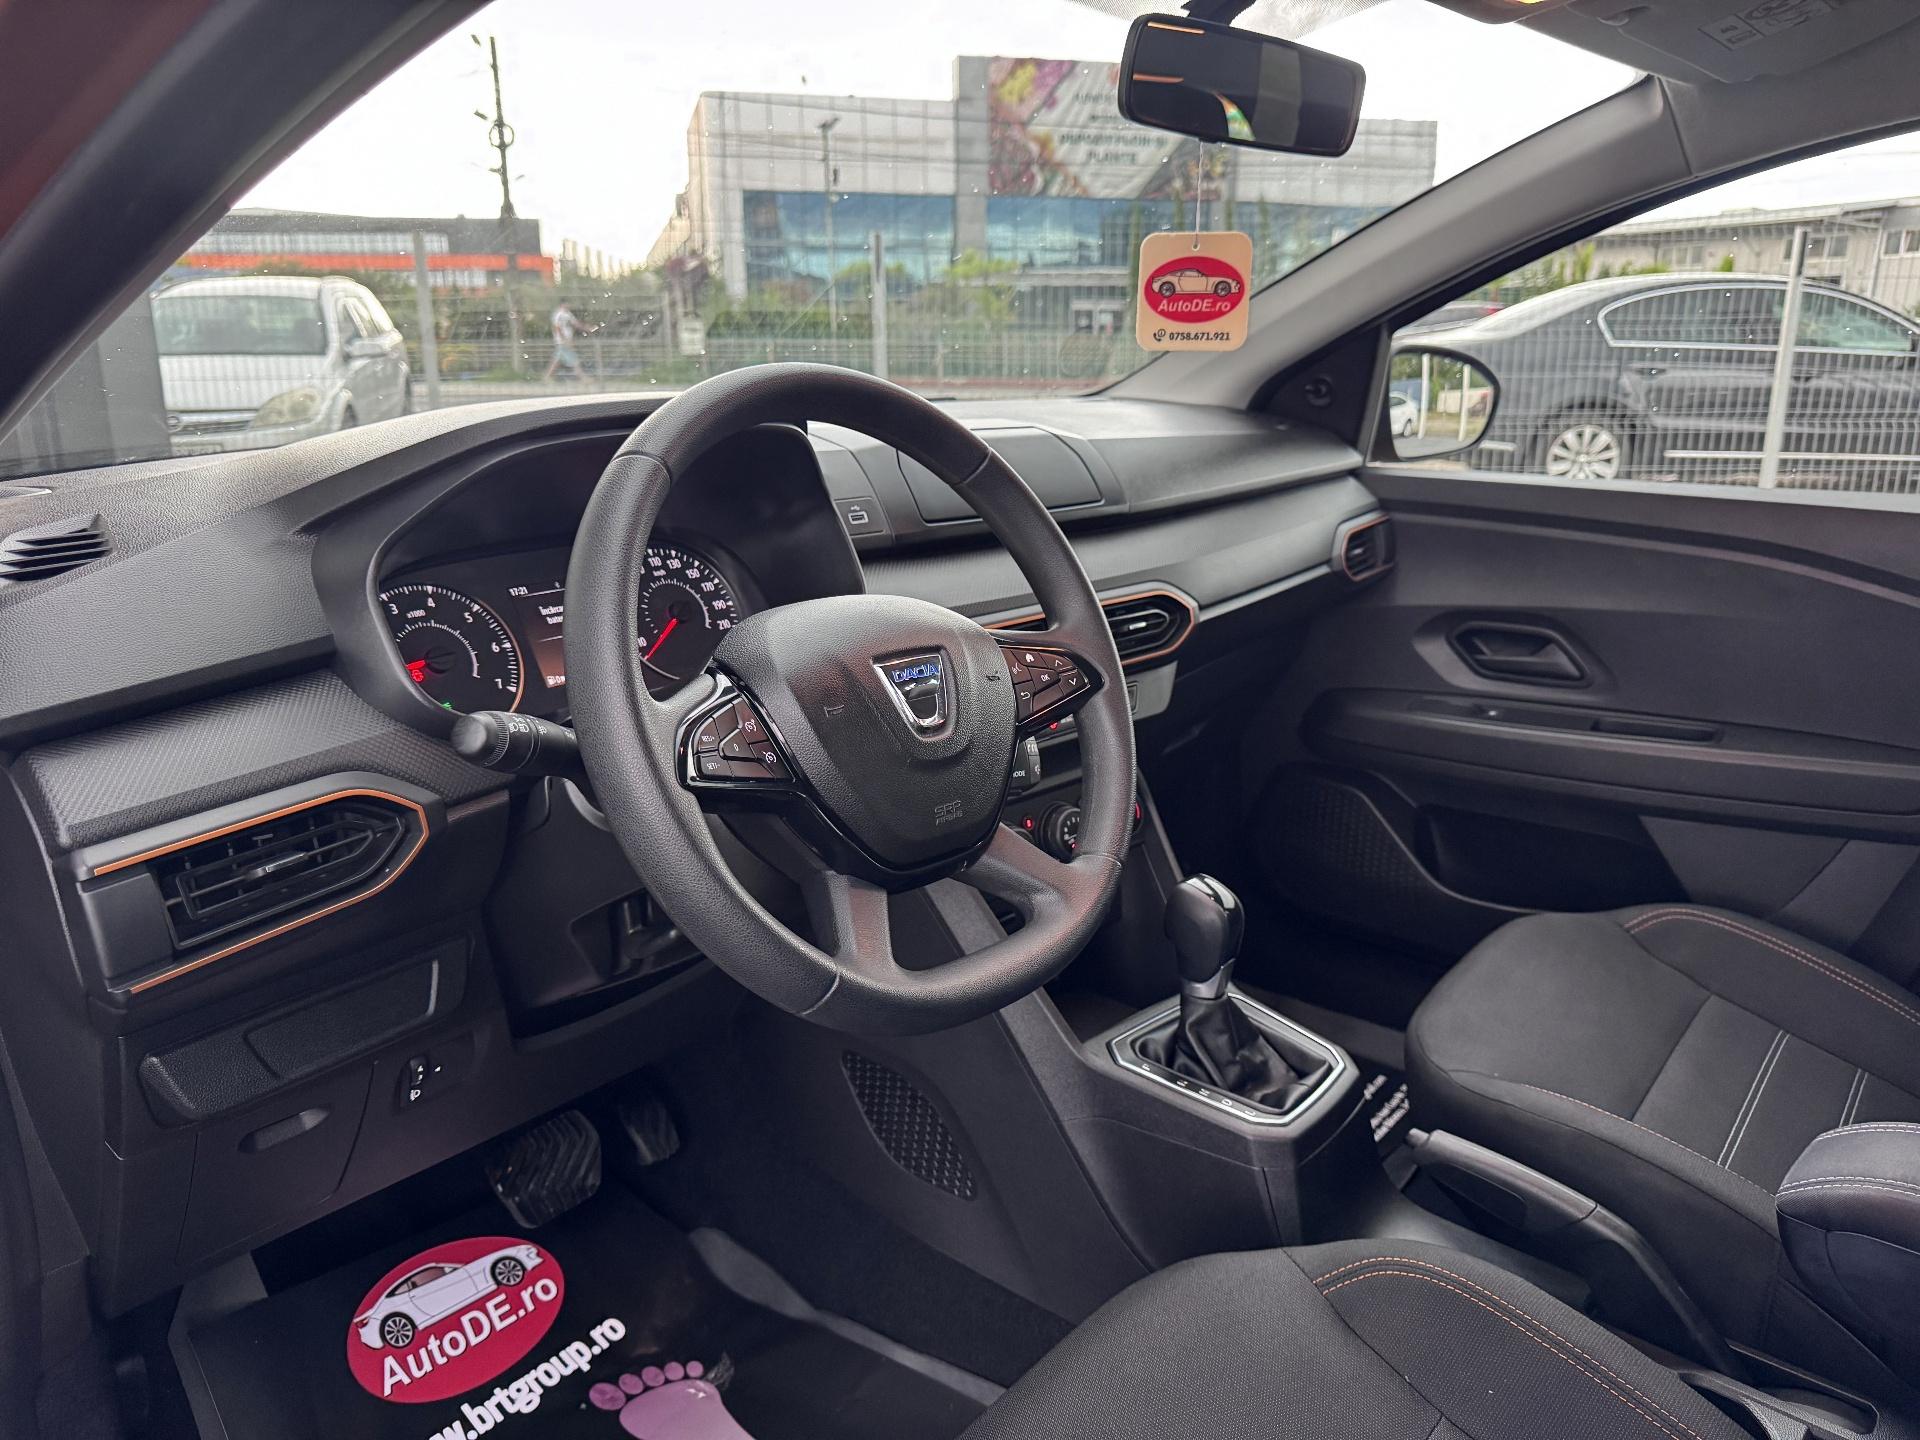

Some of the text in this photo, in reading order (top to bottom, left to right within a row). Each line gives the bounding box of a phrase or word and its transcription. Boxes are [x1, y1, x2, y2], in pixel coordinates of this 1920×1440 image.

[1157, 299, 1231, 312] AutoDE.ro
[1169, 332, 1230, 341] 0758.671.921
[648, 557, 662, 567] 110
[666, 558, 681, 569] 130
[686, 568, 700, 579] 150
[509, 586, 528, 596] 17:21
[701, 581, 715, 592] 170
[427, 597, 436, 608] 4
[712, 600, 727, 611] 190
[388, 603, 399, 615] 3
[463, 612, 473, 623] 5
[717, 619, 731, 630] 210
[491, 641, 500, 653] 6
[891, 664, 939, 682] DACIA
[1040, 673, 1051, 682] OK
[494, 678, 503, 689] 7
[383, 1278, 558, 1397] AutoDE.ro
